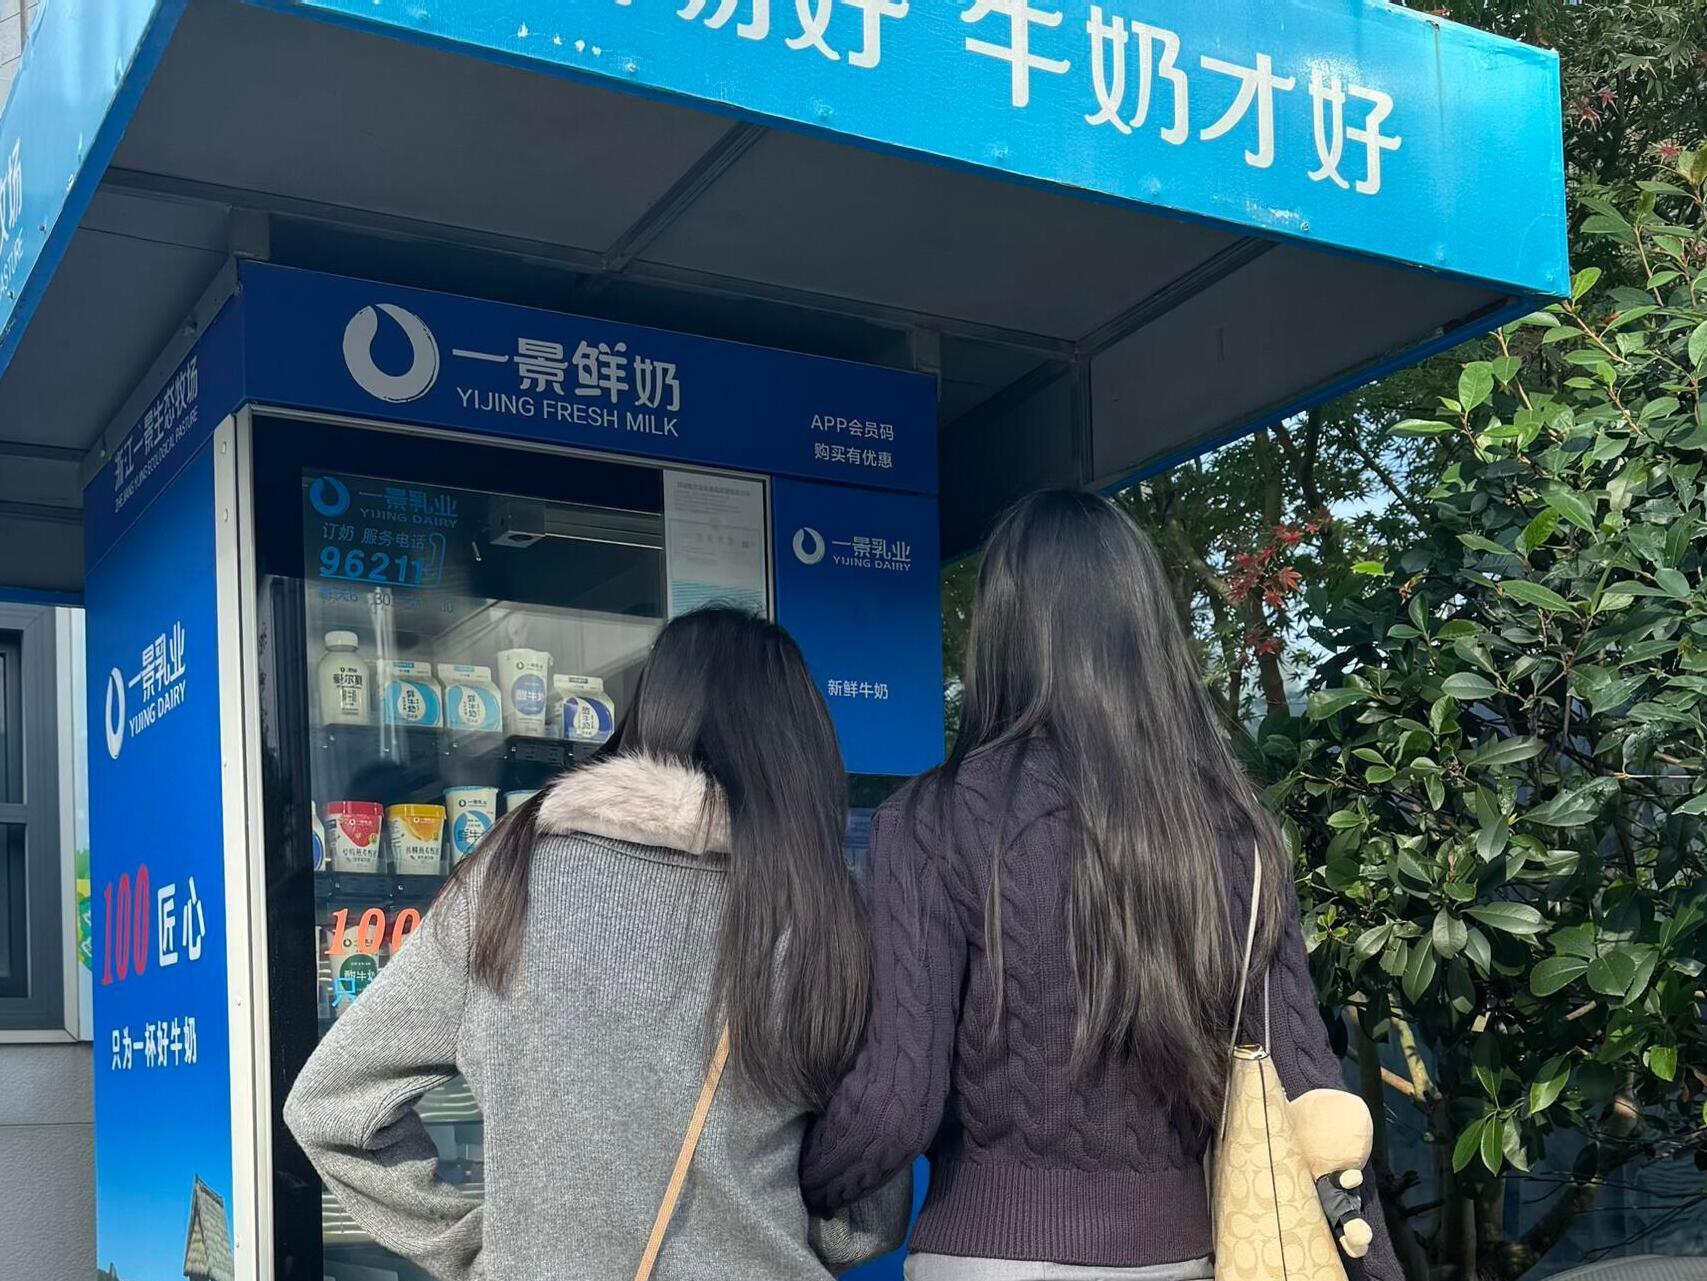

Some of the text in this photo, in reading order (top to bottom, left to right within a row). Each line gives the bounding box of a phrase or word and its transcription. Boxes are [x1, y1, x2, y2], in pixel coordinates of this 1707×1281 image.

[960, 0, 1402, 195] 牛奶才好
[452, 337, 681, 411] 一景鲜奶
[456, 387, 679, 437] YIJING FRESH MILK
[811, 414, 894, 441] APP会员码
[814, 443, 893, 468] 购买有优惠
[359, 487, 459, 517] 一景乳业
[359, 507, 459, 529] YIJING DAIRY
[322, 522, 426, 550] 订奶 服务电话
[831, 536, 911, 562] 一景乳业
[320, 546, 425, 585] 96211
[833, 555, 911, 572] YIJING DAIRY
[128, 621, 186, 703] 一景乳业
[827, 679, 889, 700] 新鲜牛奶
[129, 679, 186, 738] YIJING DAIRY
[102, 864, 206, 986] 100 匠心
[112, 1015, 198, 1071] 只为一杯好牛奶
